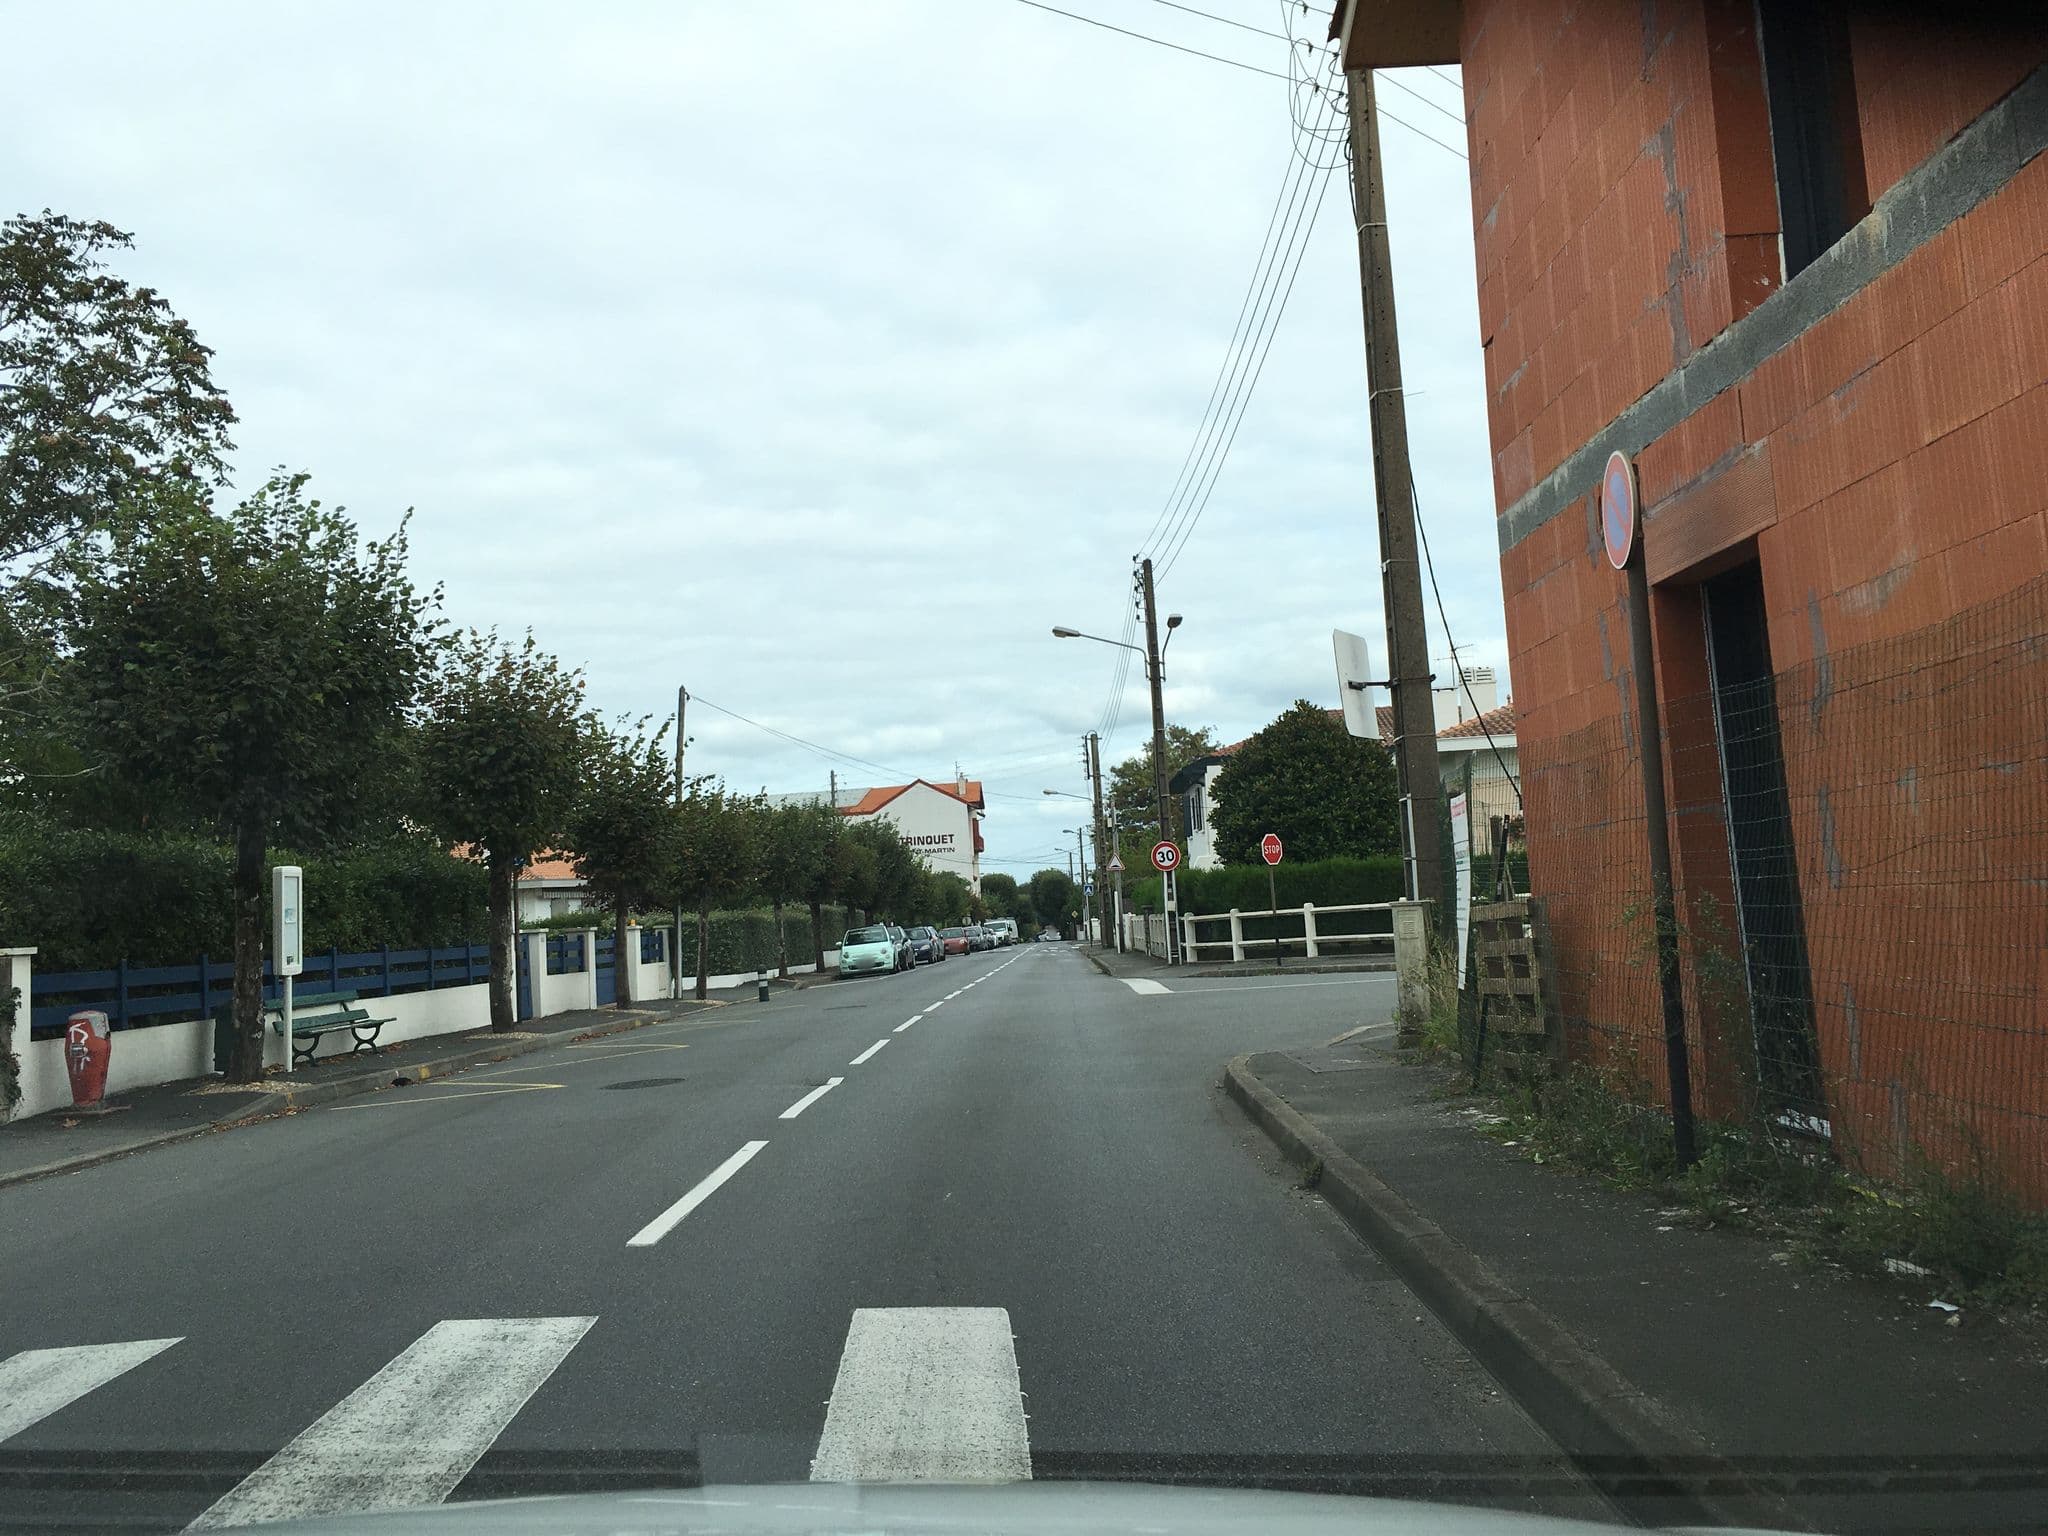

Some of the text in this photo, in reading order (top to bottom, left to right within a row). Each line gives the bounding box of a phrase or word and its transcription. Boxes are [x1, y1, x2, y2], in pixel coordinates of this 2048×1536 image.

[899, 834, 955, 846] TRINQUET
[1264, 845, 1280, 854] STOP
[1157, 850, 1175, 863] 30
